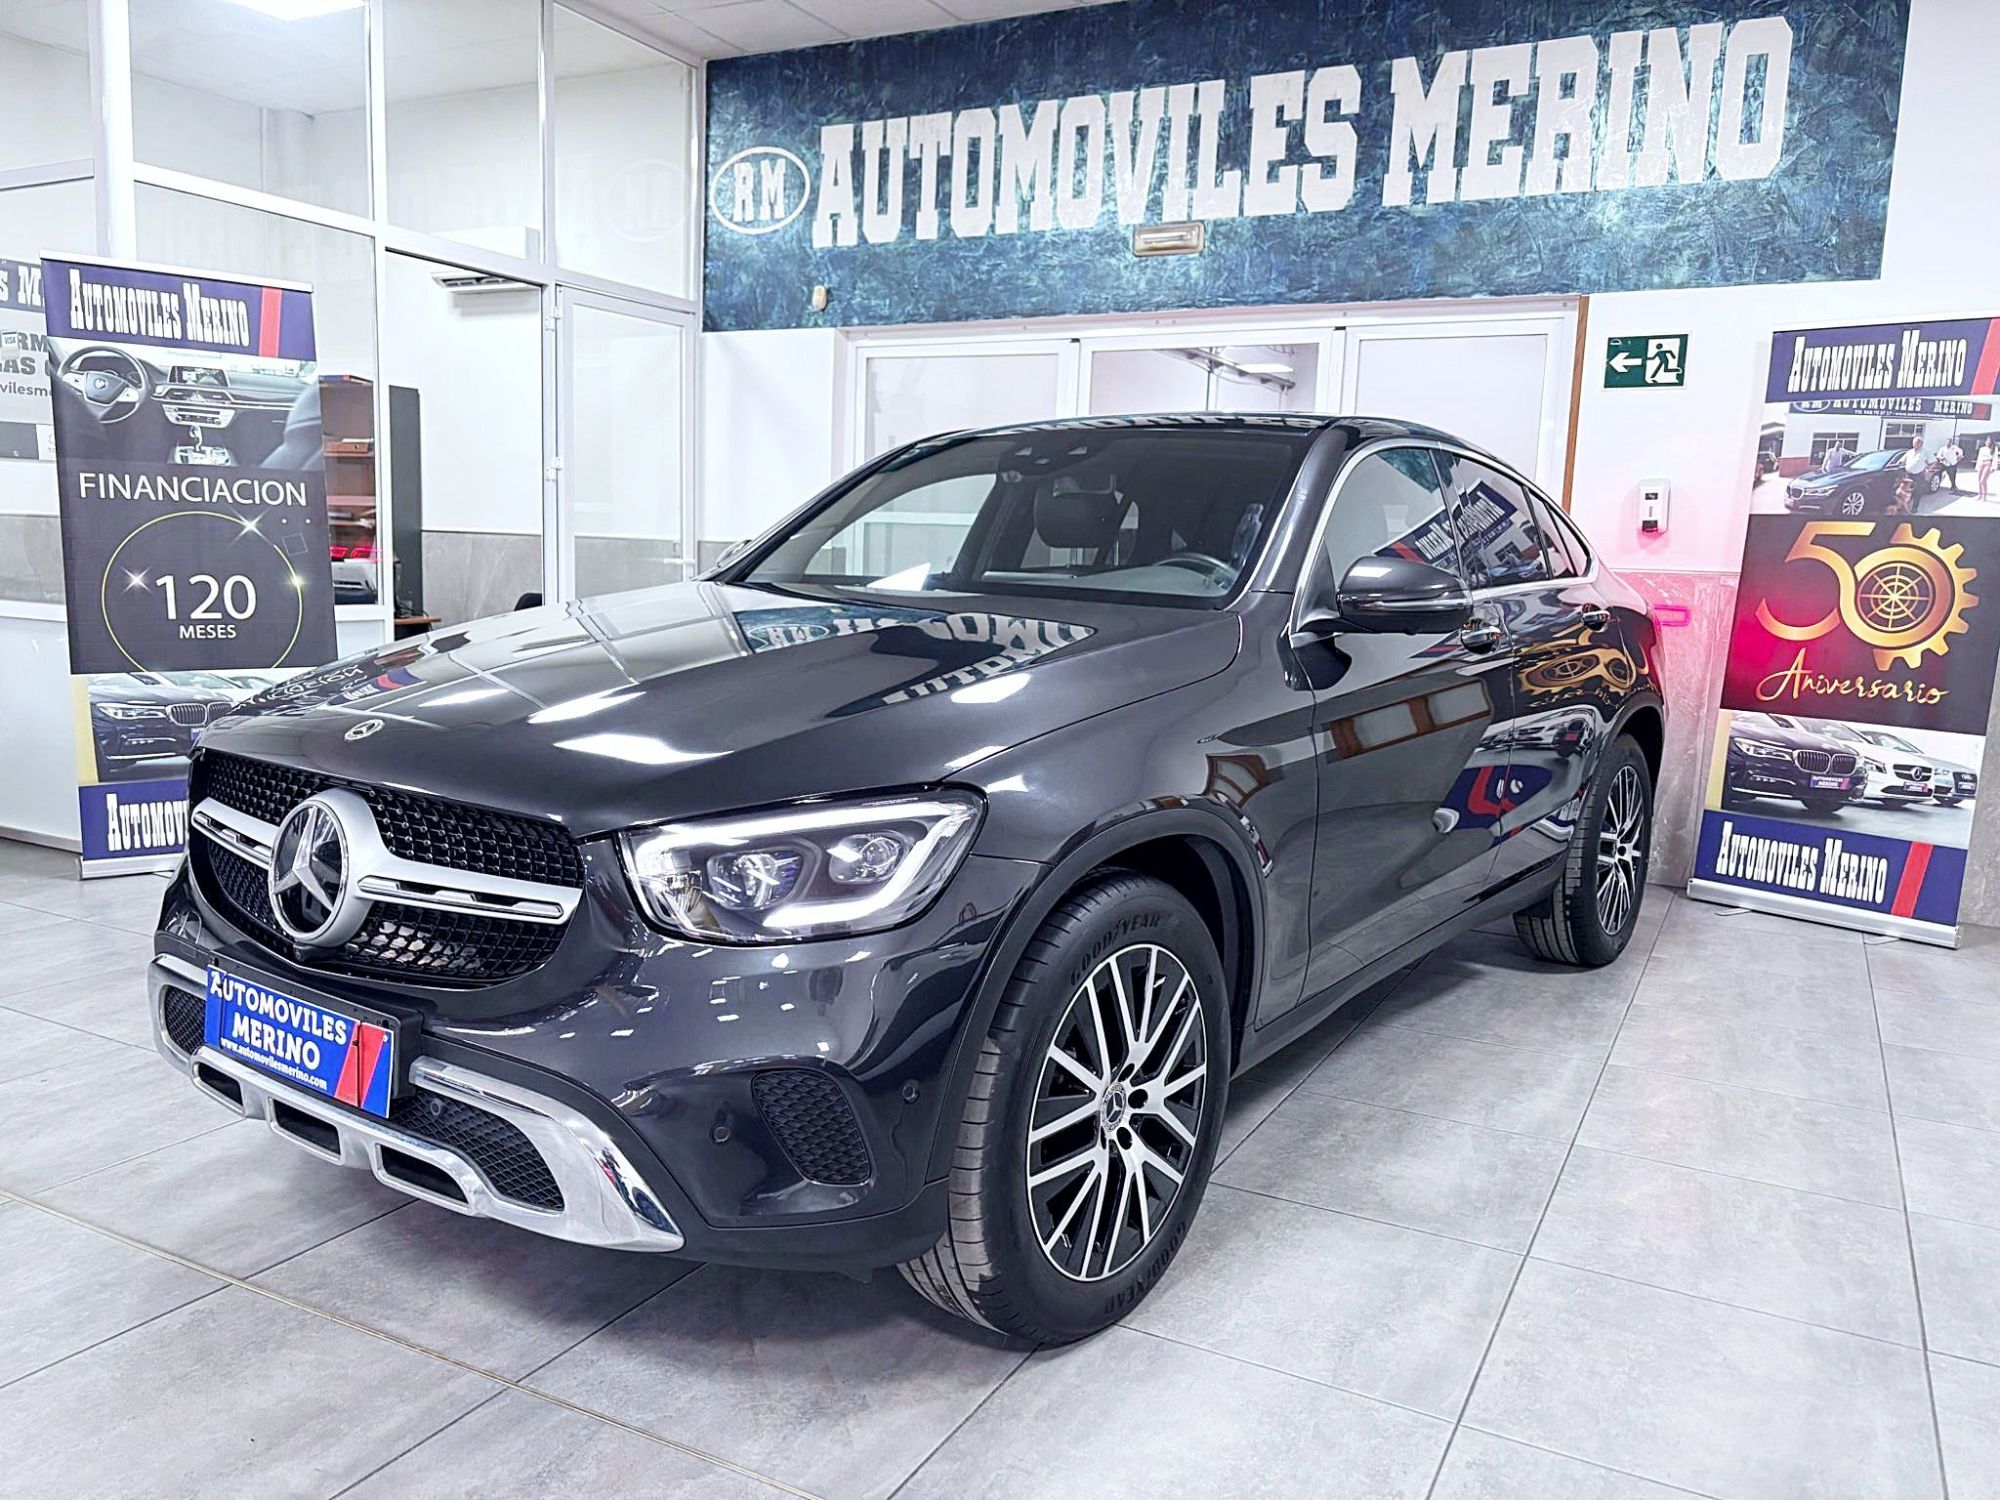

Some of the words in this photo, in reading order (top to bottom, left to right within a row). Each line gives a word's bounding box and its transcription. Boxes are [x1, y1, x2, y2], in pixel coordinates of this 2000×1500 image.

[812, 65, 1360, 249] AUTOMOVILES
[1382, 16, 1794, 207] MERINO
[733, 160, 786, 223] RM
[69, 268, 182, 340] AUTOMOVILES
[182, 282, 250, 347] MERINO
[0, 381, 52, 397] vilesm
[1787, 336, 1896, 393] AUTOMOVILES
[1897, 329, 1968, 389] MERINO
[1933, 399, 1974, 416] MERINO
[78, 472, 308, 507] FINANCIACION
[155, 574, 258, 621] 120
[1755, 521, 1980, 672] 50
[179, 624, 237, 640] MESES
[1755, 647, 1949, 705] Aniversario
[1715, 821, 1819, 892] AUTOMOVILES
[1819, 838, 1888, 904] MERINO
[209, 970, 348, 1046] AUTOMOVILES
[231, 1012, 321, 1071] MERINO
